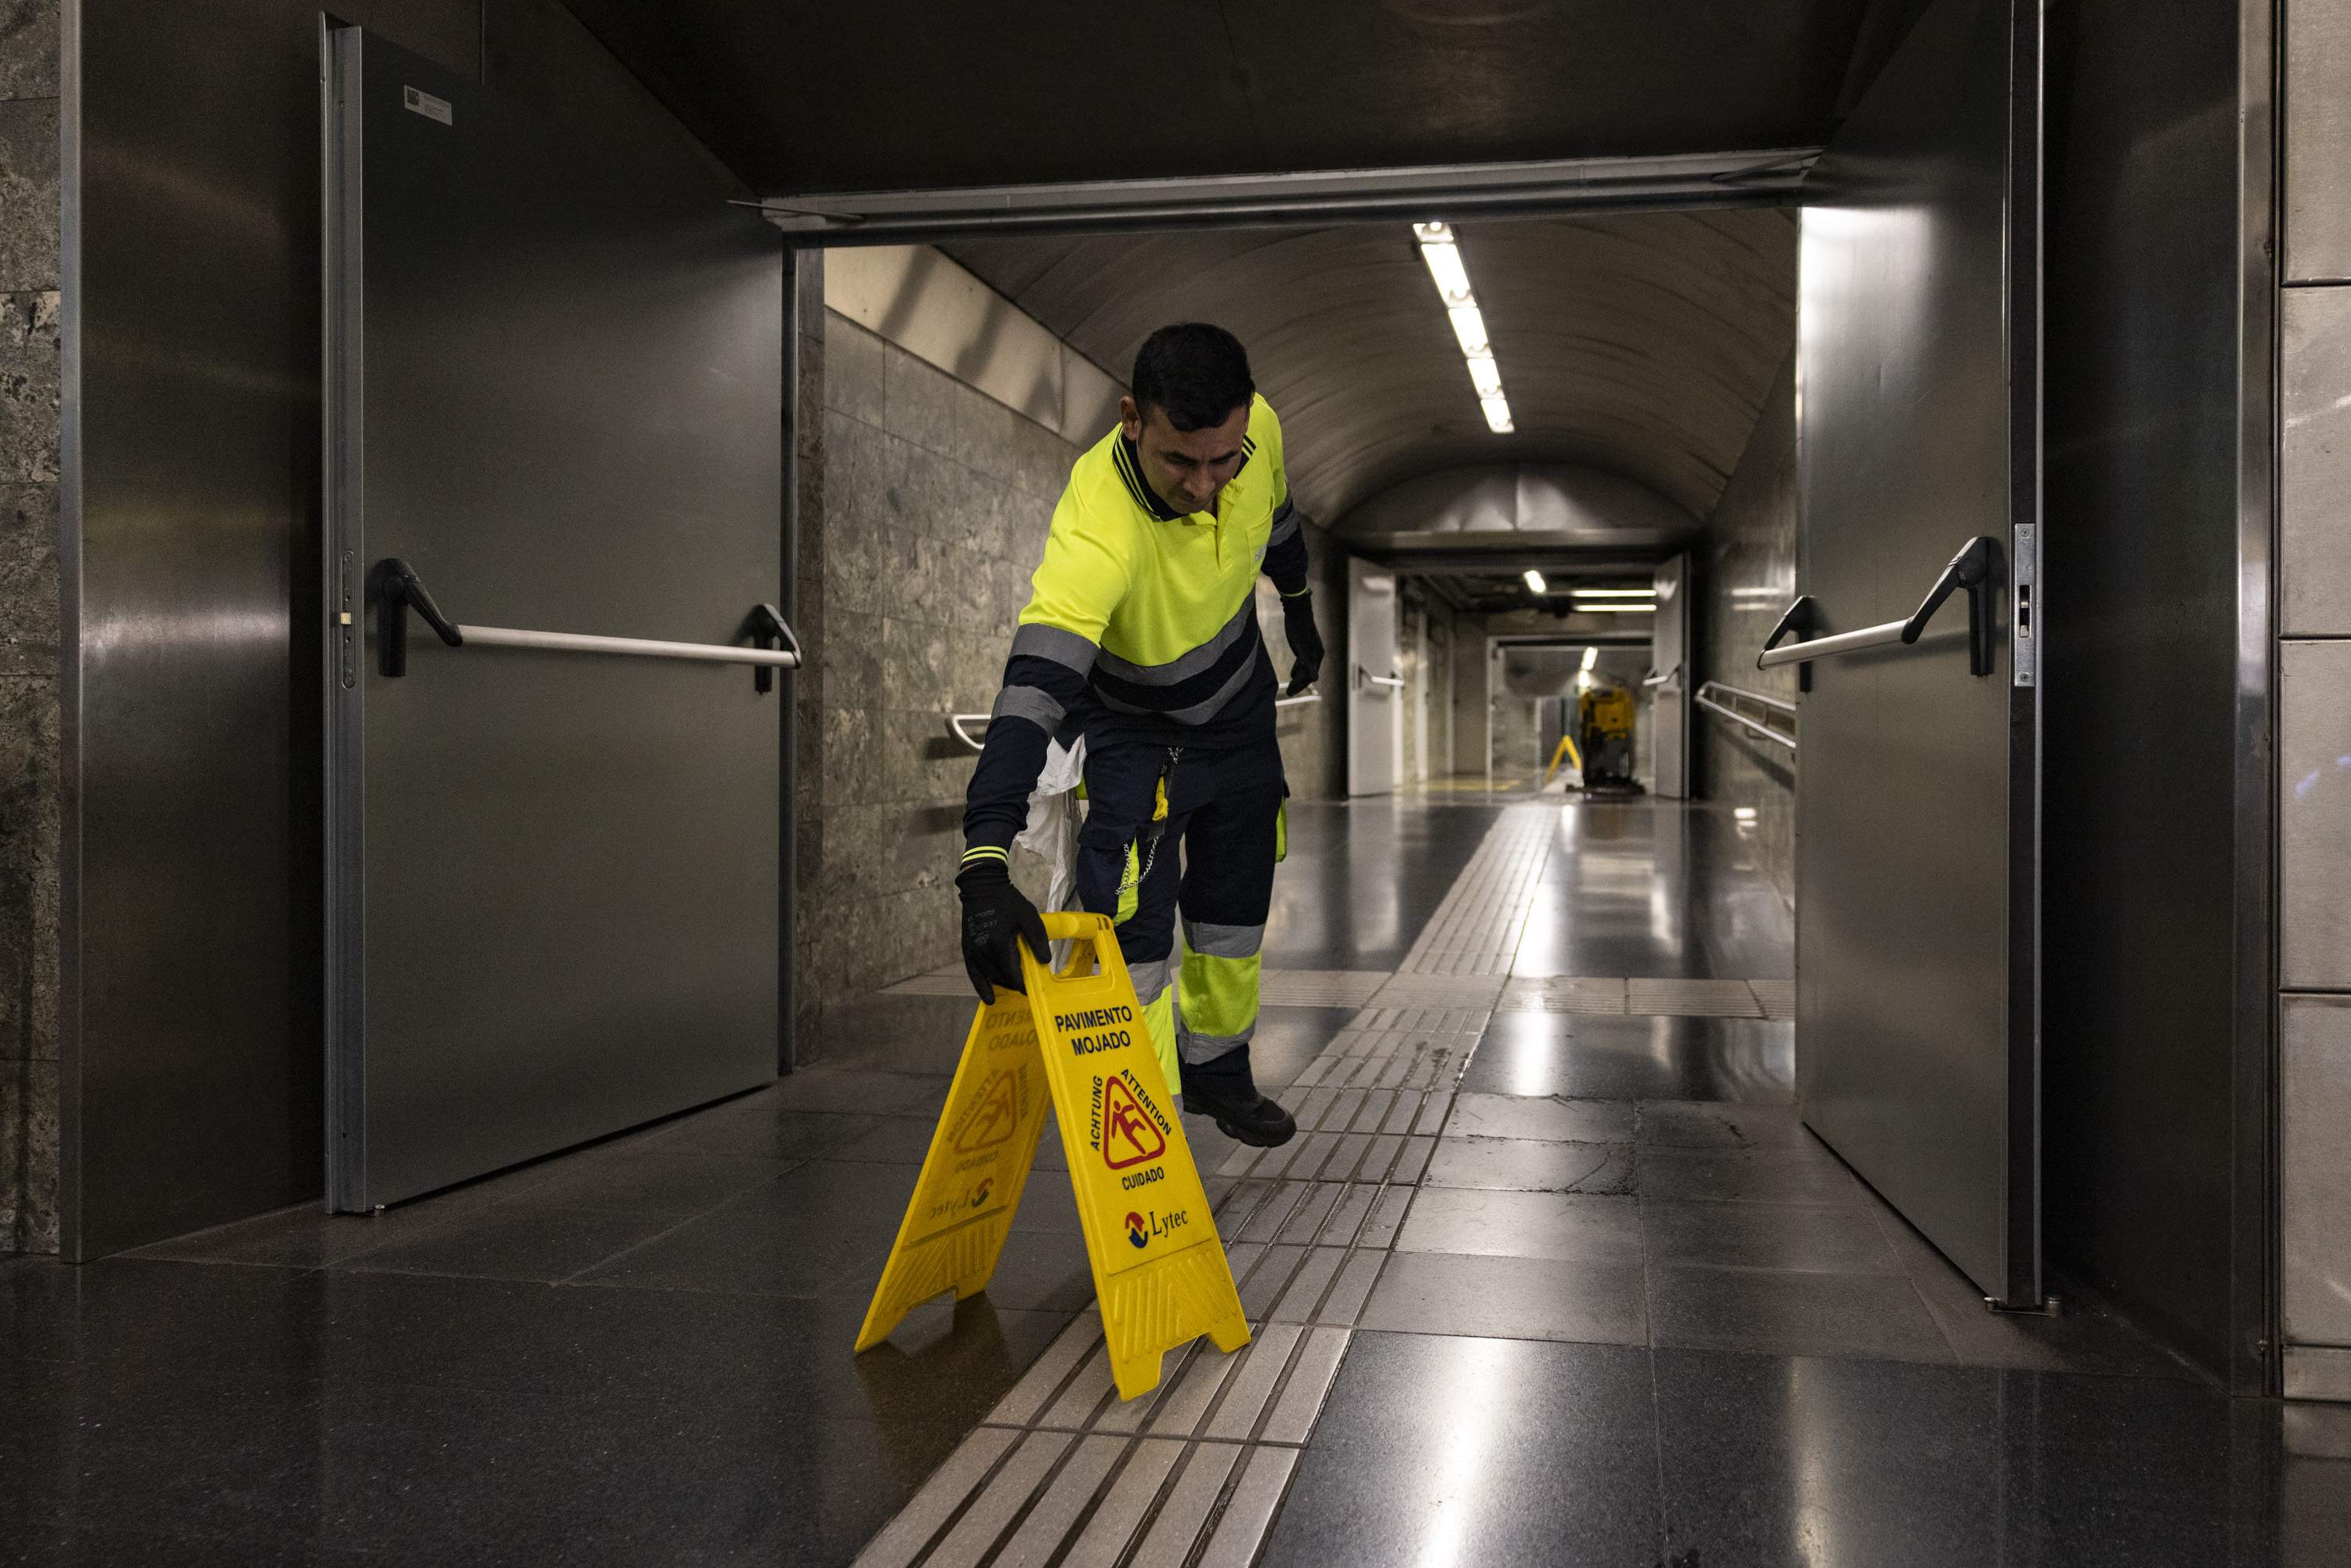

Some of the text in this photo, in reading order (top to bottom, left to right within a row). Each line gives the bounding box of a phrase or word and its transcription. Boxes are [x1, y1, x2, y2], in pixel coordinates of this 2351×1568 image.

[1055, 1005, 1132, 1033] PAVIMENTO
[1071, 1030, 1132, 1056] MOJADO
[1090, 1075, 1103, 1152] ACHTUNG
[1121, 1068, 1172, 1136] ATTENTION
[1121, 1166, 1165, 1190] CUIDADO
[1150, 1208, 1189, 1238] Lytec
